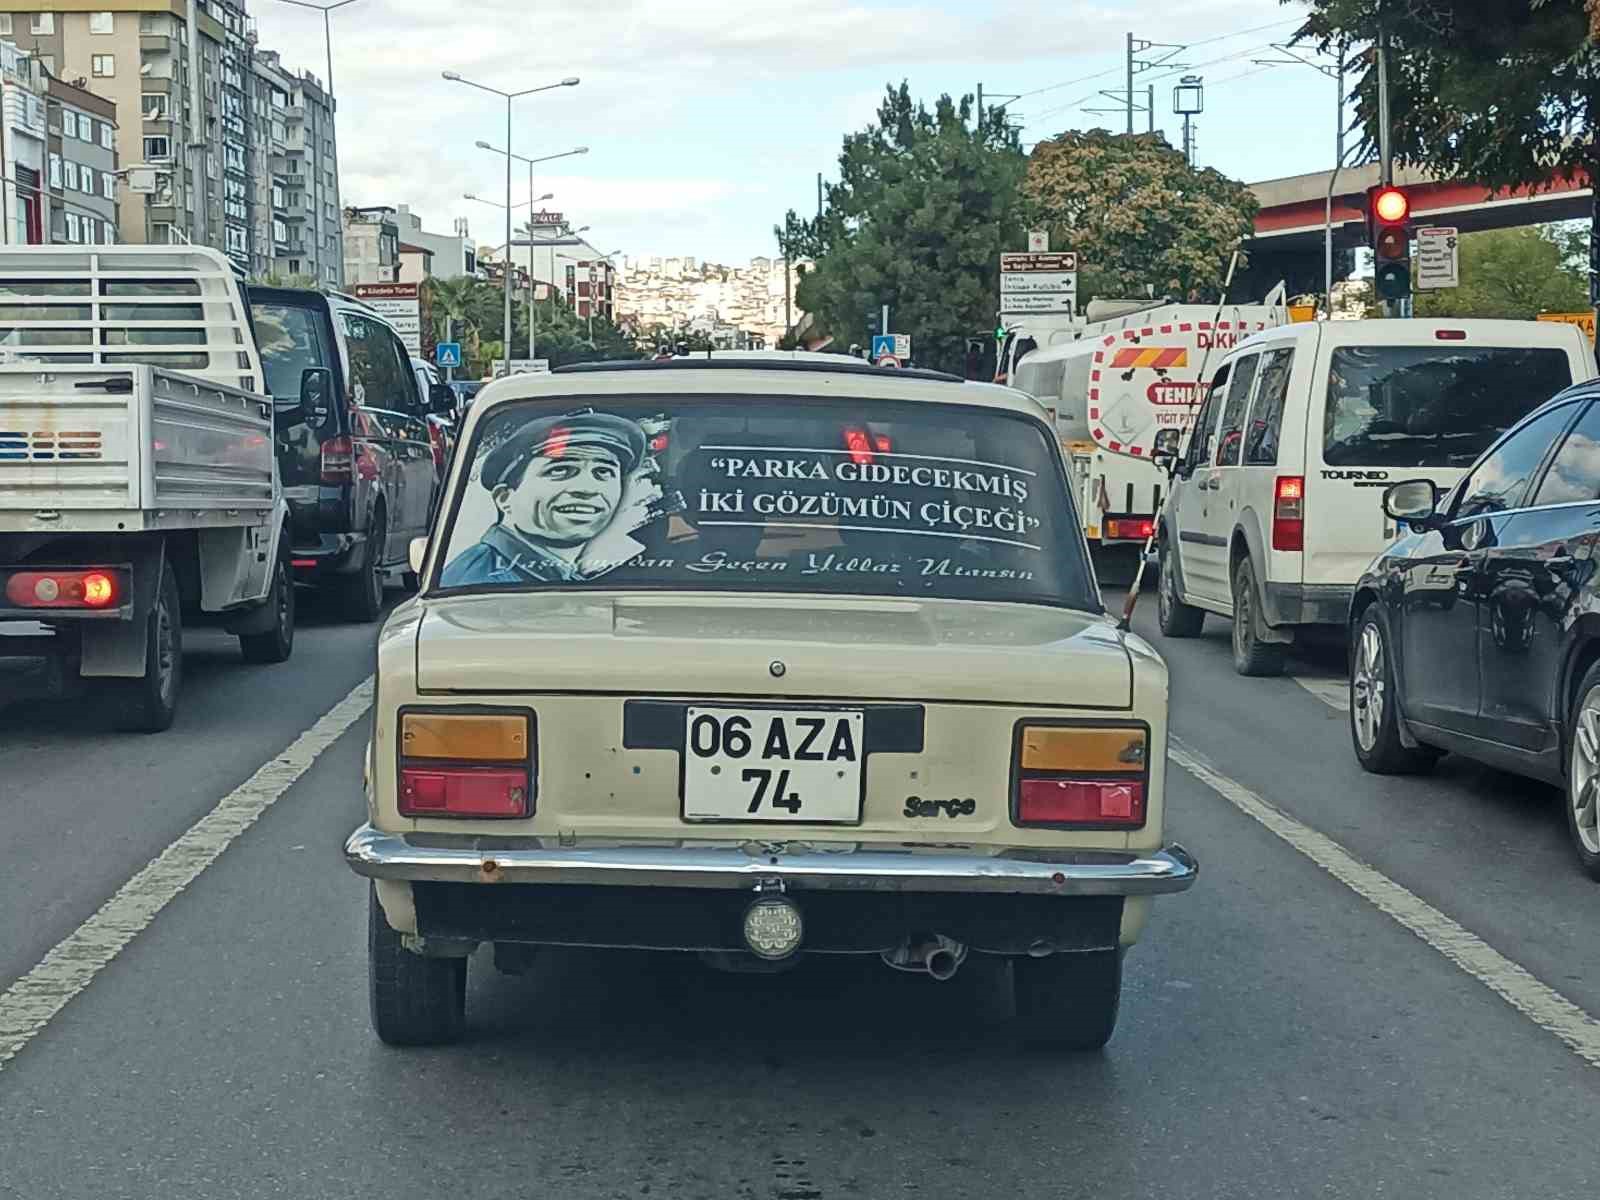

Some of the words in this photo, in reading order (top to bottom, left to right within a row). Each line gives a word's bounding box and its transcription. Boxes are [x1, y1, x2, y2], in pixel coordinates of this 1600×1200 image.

[711, 457, 829, 480] “PARKA
[835, 459, 1028, 503] GİDECEKMİŞ
[1319, 470, 1388, 480] TOURNEO
[698, 488, 744, 513] İKİ
[752, 490, 912, 520] GÖZÜMÜN
[920, 500, 1040, 534] ÇİÇEĞİ”
[685, 551, 788, 573] Geçen
[691, 714, 752, 758] 06
[761, 717, 856, 761] AZA
[742, 768, 802, 814] 74
